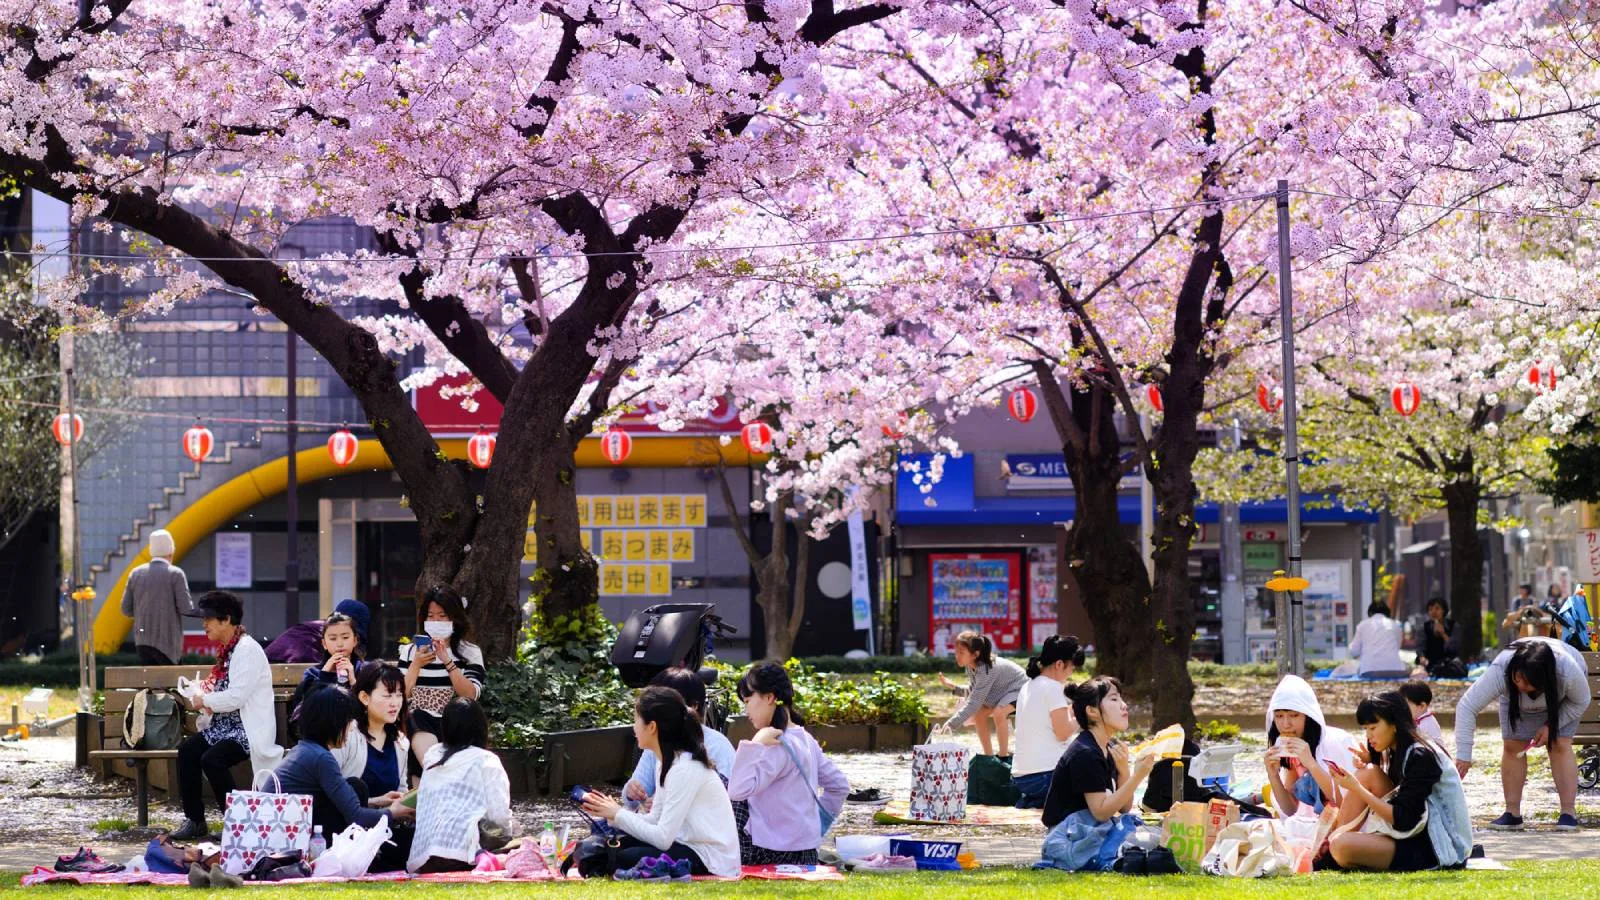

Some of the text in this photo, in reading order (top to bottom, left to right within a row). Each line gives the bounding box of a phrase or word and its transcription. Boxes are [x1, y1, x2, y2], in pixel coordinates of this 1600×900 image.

[604, 537, 692, 555] おつまみ
[922, 842, 958, 858] VISA
